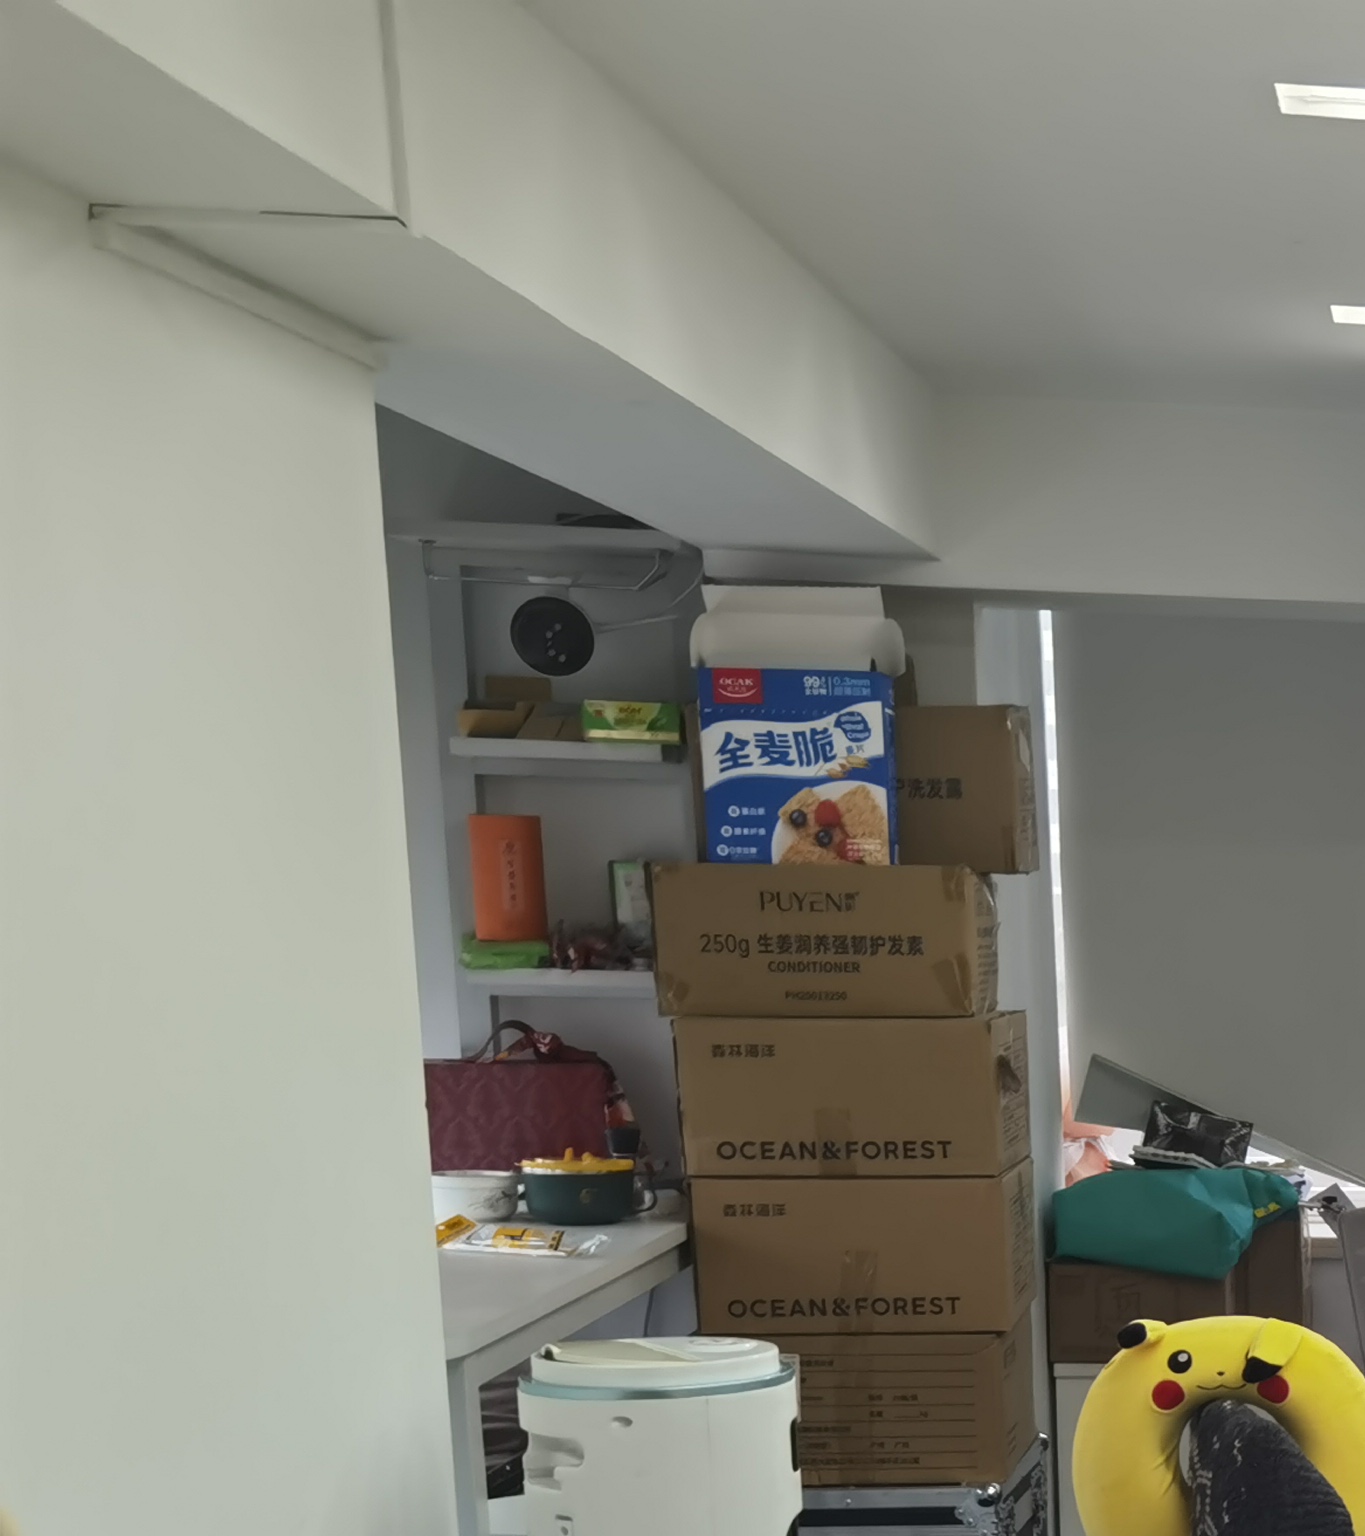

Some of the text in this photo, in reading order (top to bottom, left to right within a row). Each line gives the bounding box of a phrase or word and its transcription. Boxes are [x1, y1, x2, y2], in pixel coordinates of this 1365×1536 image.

[714, 726, 838, 774] 全麦脆
[759, 890, 843, 912] PUYEN
[699, 934, 751, 958] 250g
[767, 960, 861, 974] CONDITIONER
[711, 1043, 776, 1059] 森林海洋
[715, 1140, 953, 1161] OCEAN&FOREST
[722, 1203, 787, 1217] 森林海洋
[727, 1296, 961, 1319] OCEAN&FOREST
